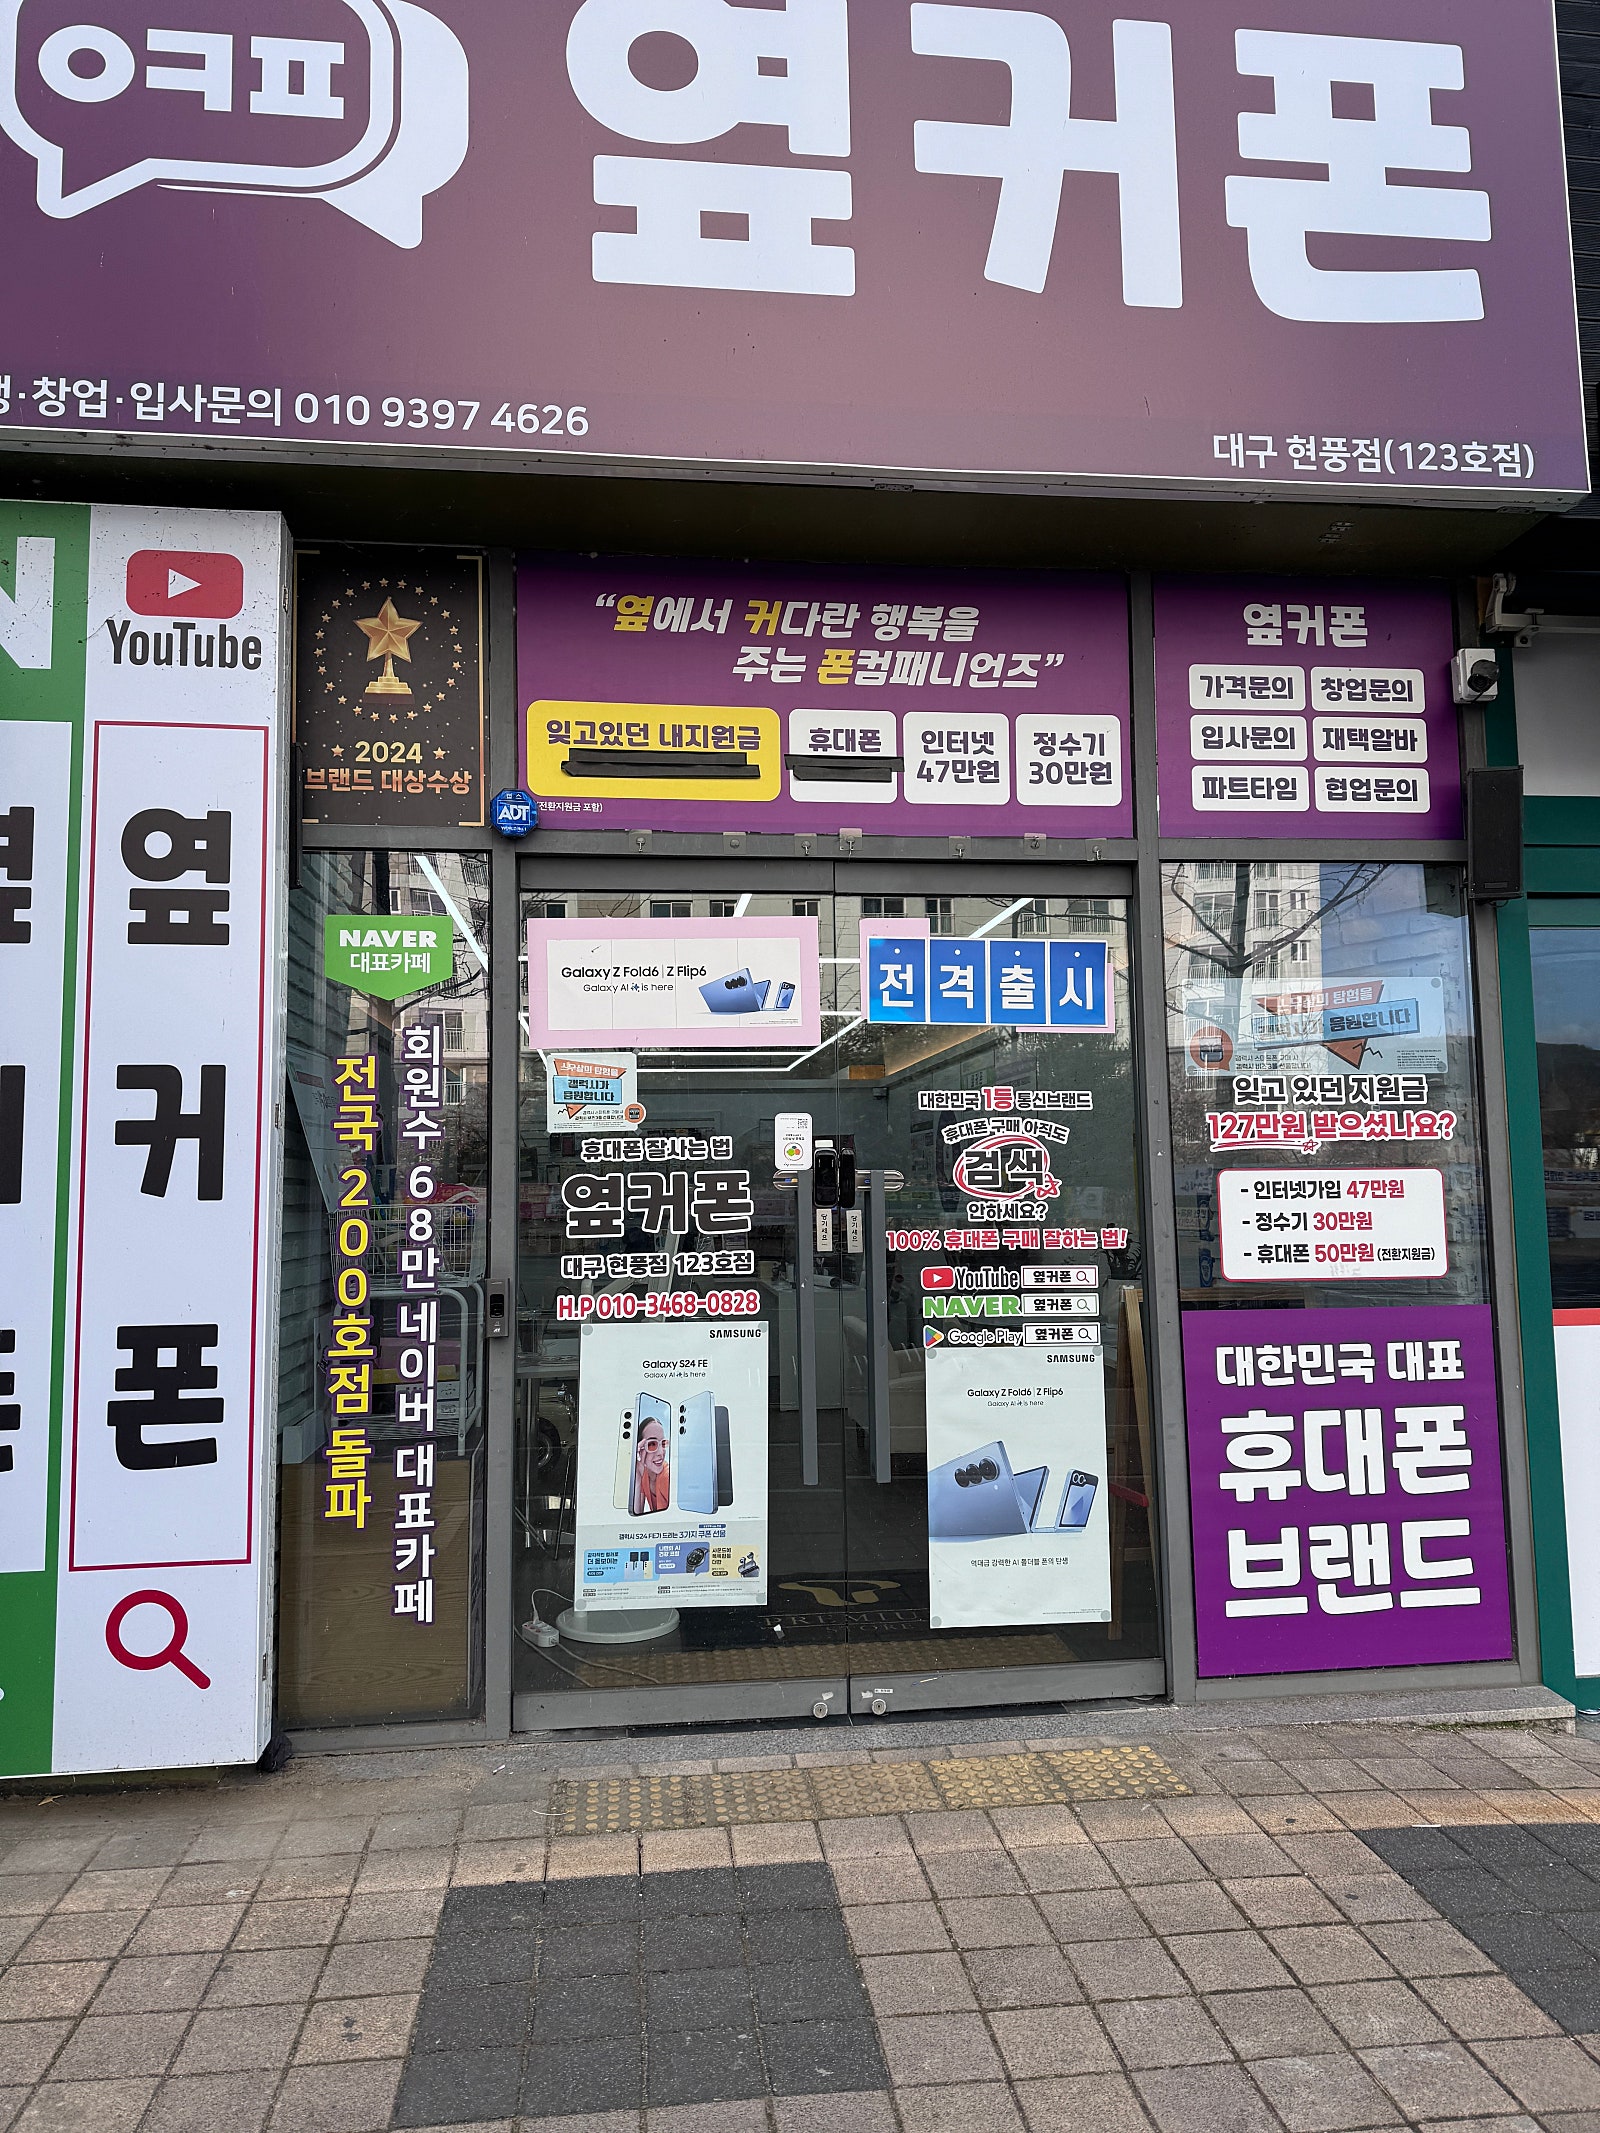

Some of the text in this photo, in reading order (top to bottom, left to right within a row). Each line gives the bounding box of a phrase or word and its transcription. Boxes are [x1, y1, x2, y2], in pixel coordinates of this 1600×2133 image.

[566, 0, 1491, 323] 옆커폰
[294, 392, 370, 427] 010
[381, 395, 480, 432] 9397
[490, 401, 590, 437] 4626
[1213, 433, 1535, 480] 대구 현풍점(123호점)
[744, 600, 861, 639] 커다란
[871, 603, 980, 642] 행복을
[1243, 603, 1368, 648] 옆커폰
[106, 620, 262, 671] YouTube
[732, 646, 807, 683] 주는
[1199, 674, 1294, 700] 가격문의
[1321, 677, 1414, 704] 창업문의
[546, 720, 761, 751] 잊고있던 내지원금
[808, 728, 882, 753] 휴대폰
[921, 730, 995, 756] 인터넷
[1033, 732, 1106, 757] 정수기
[1201, 725, 1296, 751] 입사문의
[1322, 727, 1418, 753] 재택알바
[354, 741, 423, 764] 2024
[304, 768, 472, 795] 브랜드 대상수상
[917, 760, 1000, 784] 47만원
[1029, 761, 1112, 786] 30만원
[1202, 775, 1297, 802] 파트타임
[1325, 777, 1418, 802] 협업문의
[498, 804, 529, 821] ADT
[583, 802, 603, 813] 포함)
[339, 930, 437, 948] NAVER
[350, 952, 431, 974] 대표카페
[561, 965, 707, 980] Galaxy Z Fold6 Z Flip6
[583, 982, 674, 993] Galaxy AI is here
[879, 964, 1093, 1010] 전격출시
[1333, 986, 1372, 1005] 탐험을
[1329, 1007, 1411, 1033] 응원합니다
[402, 1025, 443, 1150] 회원수
[920, 1087, 1092, 1110] 대한민국 1등 통신브랜드
[1235, 1076, 1427, 1104] 잊고 있던 지원금
[333, 1055, 379, 1151] 전국
[943, 1117, 1069, 1143] 휴대폰 구매 아직도
[1206, 1111, 1456, 1140] 127만원 받으셨나요?
[105, 807, 232, 1472] 옆커폰
[582, 1137, 731, 1161] 휴대폰 잘사는 법
[964, 1149, 1045, 1187] 검색
[1253, 1179, 1405, 1200] 인터넷가입 47만원
[562, 1170, 753, 1238] 옆커폰
[967, 1202, 1048, 1221] 안하세요?
[1255, 1212, 1373, 1232] 정수기 30만원
[887, 1229, 1128, 1250] 100% 휴대폰 구매 잘하는 법!
[563, 1251, 753, 1278] 대구 현풍점 123호점
[1257, 1243, 1435, 1263] 휴대폰 50만원 (전환지원금)
[955, 1267, 1020, 1290] YouTube
[1033, 1271, 1072, 1283] 옆커폰
[558, 1292, 759, 1319] H.P 010-3468-0828
[924, 1296, 1021, 1317] NAVER
[1033, 1298, 1072, 1311] 옆커폰
[709, 1329, 761, 1339] SAMSUNG
[948, 1327, 1022, 1346] Google Play
[1035, 1327, 1074, 1341] 옆커폰
[399, 1301, 437, 1432] 네이버
[642, 1359, 708, 1370] Galaxy S24 FE
[1047, 1354, 1095, 1363] SAMSUNG
[1216, 1340, 1465, 1387] 대한민국 대표
[967, 1387, 1064, 1398] Galaxy Z Fold6 Z Flip6
[1219, 1405, 1473, 1503] 휴대폰
[324, 1428, 372, 1529] 돌파
[394, 1444, 435, 1623] 대표카페
[679, 1531, 697, 1539] 3가지
[970, 1559, 990, 1568] 역대급
[992, 1558, 1011, 1567] 강력한
[1012, 1558, 1019, 1566] AI
[1055, 1557, 1069, 1566] 탄생
[1225, 1518, 1481, 1618] 브랜드
[764, 1611, 918, 1627] PREMIU
